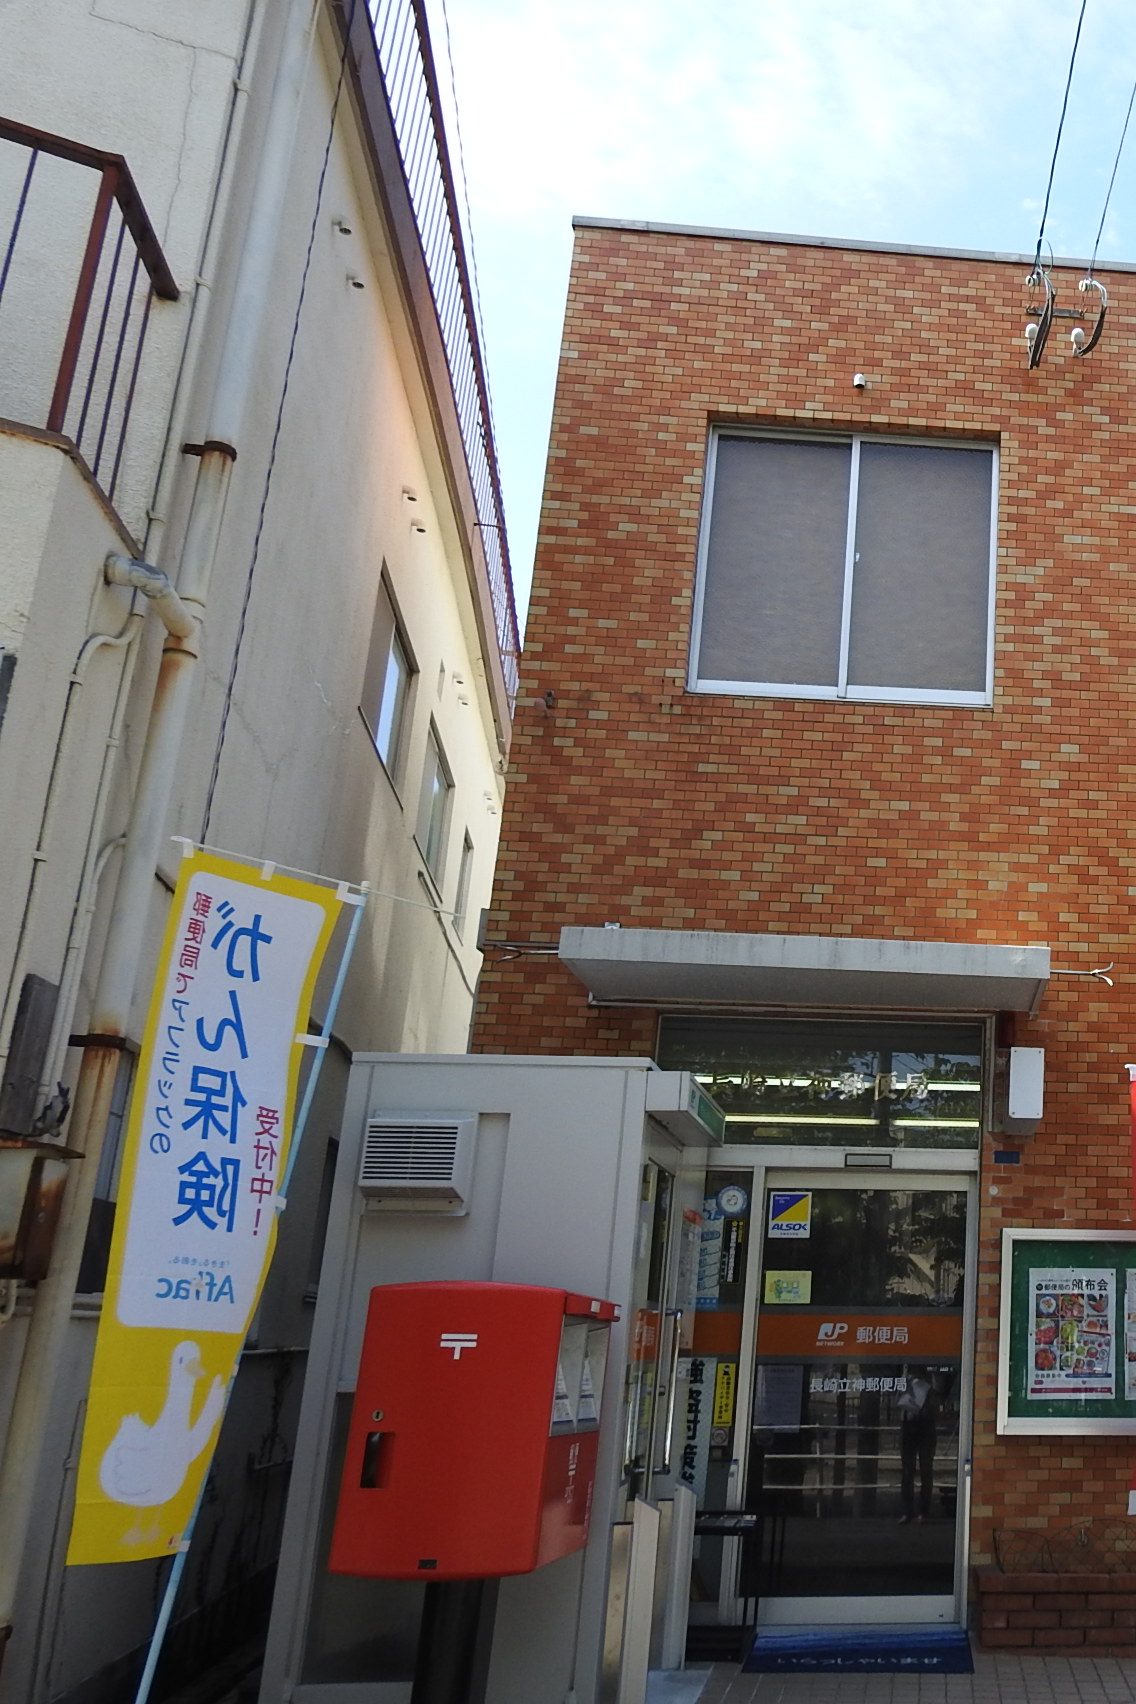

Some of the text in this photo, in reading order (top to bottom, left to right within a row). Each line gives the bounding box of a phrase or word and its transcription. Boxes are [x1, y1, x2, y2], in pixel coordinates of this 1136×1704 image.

[771, 1223, 807, 1231] ALSOK
[855, 1326, 909, 1345] 郵便局
[810, 1377, 907, 1392] 長崎立神郵便局
